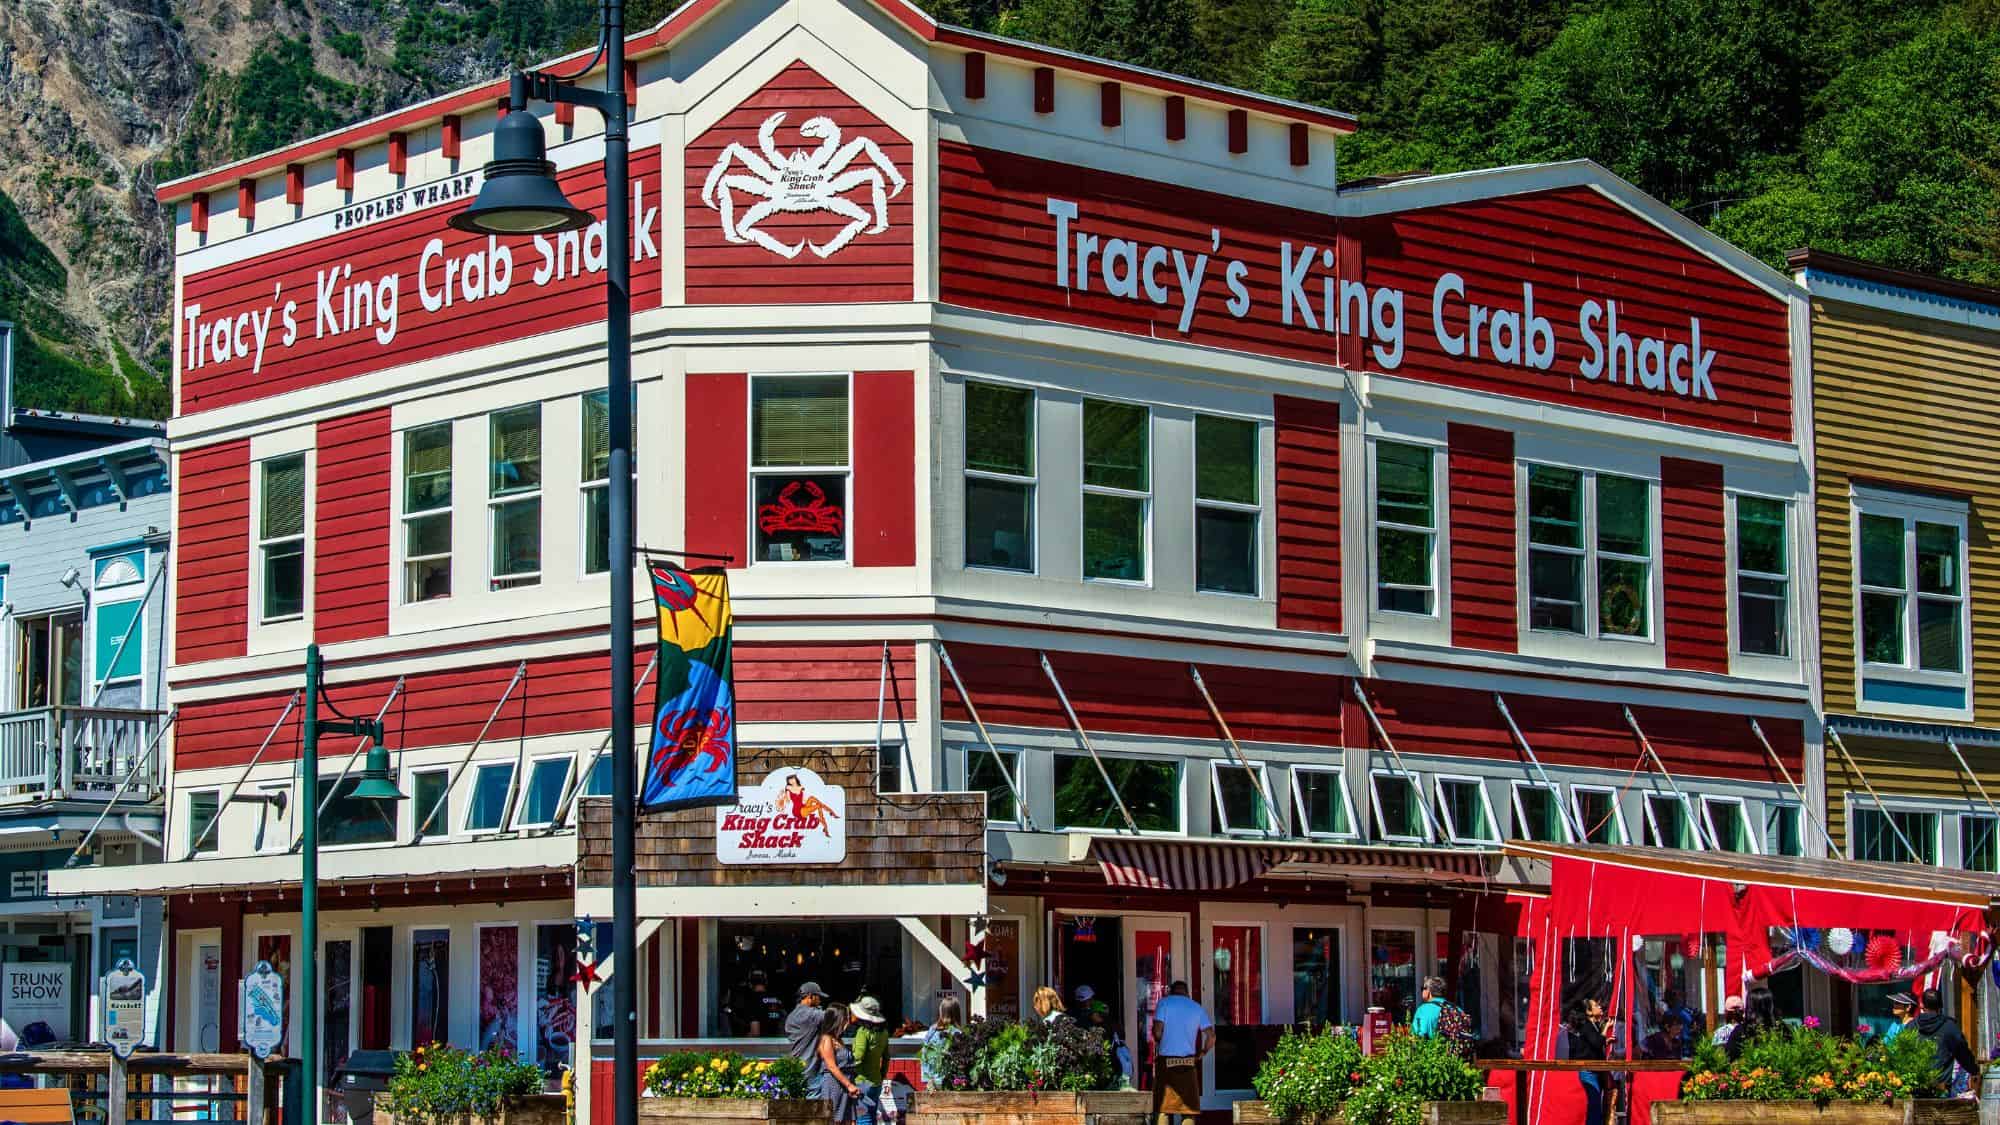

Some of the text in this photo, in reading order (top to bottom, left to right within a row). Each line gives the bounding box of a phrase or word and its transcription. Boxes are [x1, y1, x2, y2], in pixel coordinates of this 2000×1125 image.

[781, 175, 802, 183] King
[787, 182, 816, 190] Shack
[335, 175, 473, 230] PEOPLES' WHARF
[184, 180, 659, 375] Tracy's King Crab Shak
[1046, 197, 1718, 401] Tracy's King Crab Shack
[727, 797, 773, 817] racy's
[721, 814, 821, 834] King Crab
[738, 831, 804, 849] Shack
[9, 972, 64, 986] TRUNK
[11, 985, 62, 999] SHOW
